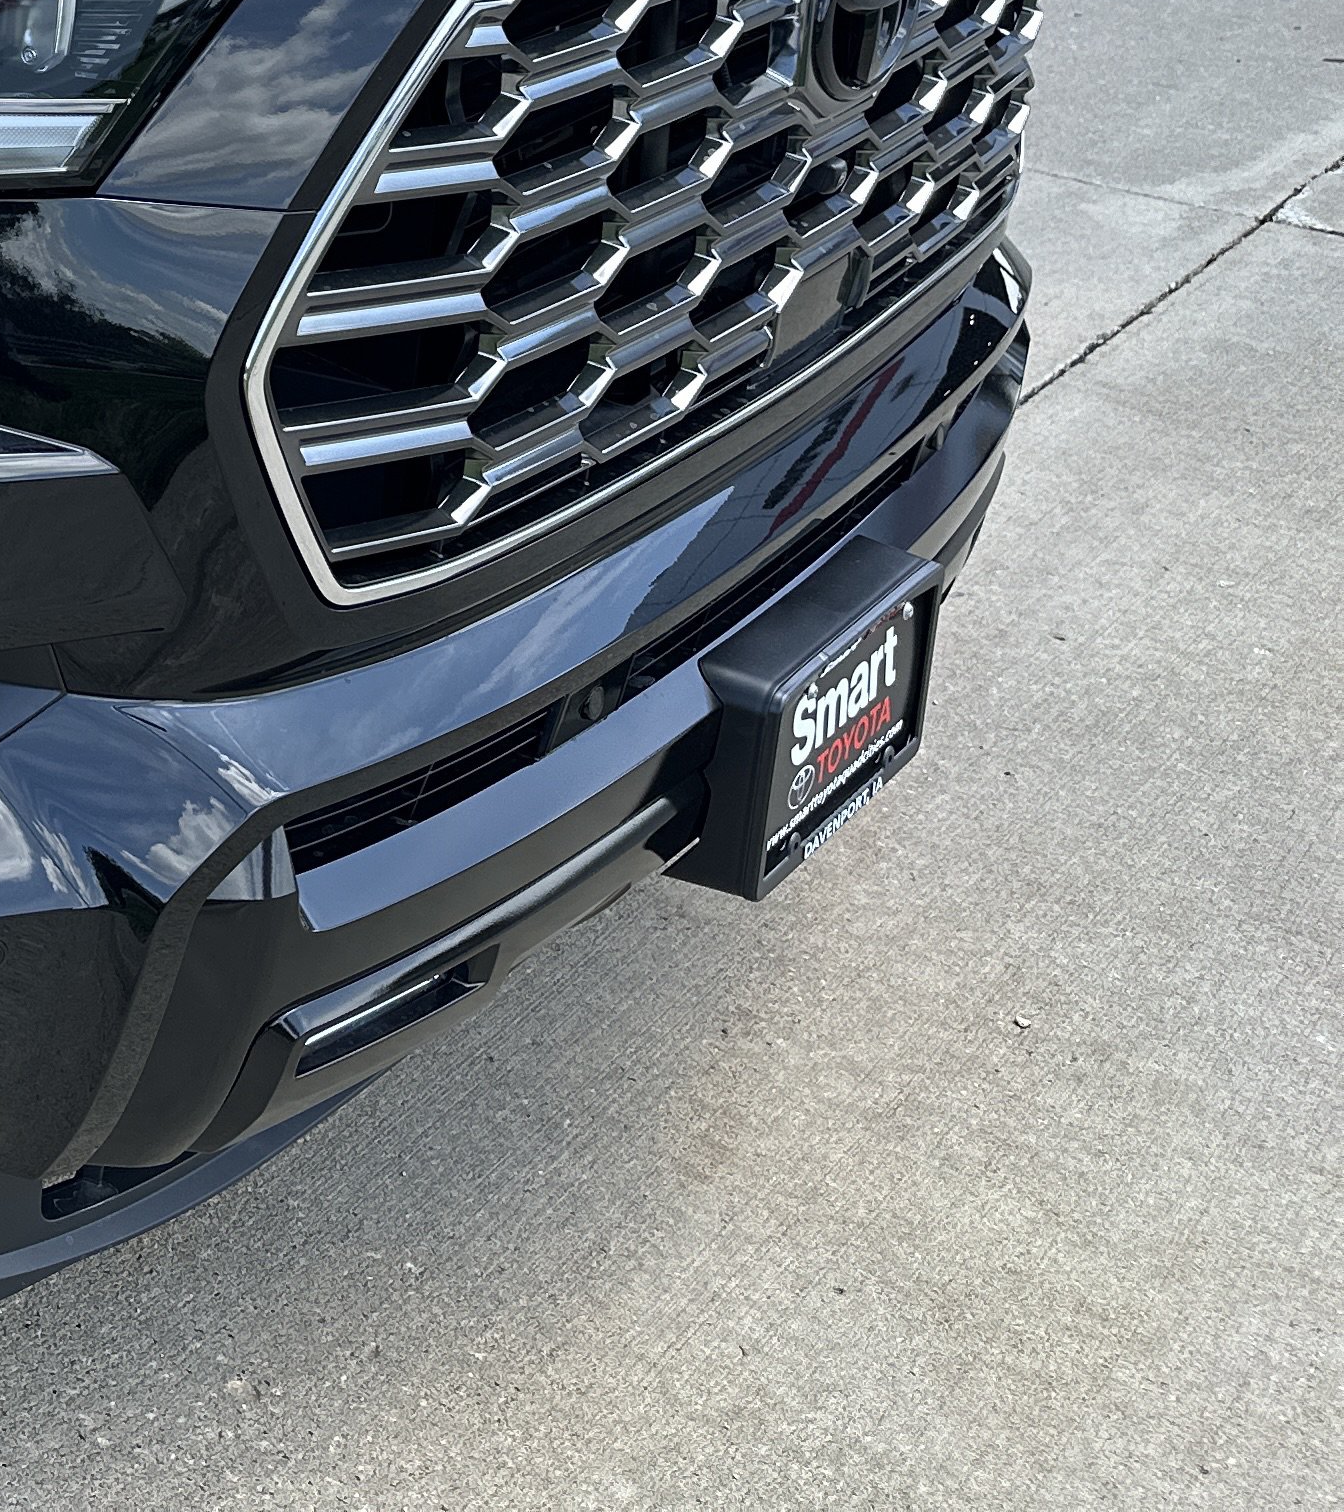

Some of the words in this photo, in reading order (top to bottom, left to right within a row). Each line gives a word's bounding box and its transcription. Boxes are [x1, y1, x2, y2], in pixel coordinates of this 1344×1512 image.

[790, 626, 898, 766] Smart
[816, 696, 892, 784] TOYOTA
[803, 786, 870, 860] DAVENPORT,
[871, 775, 884, 797] IA
